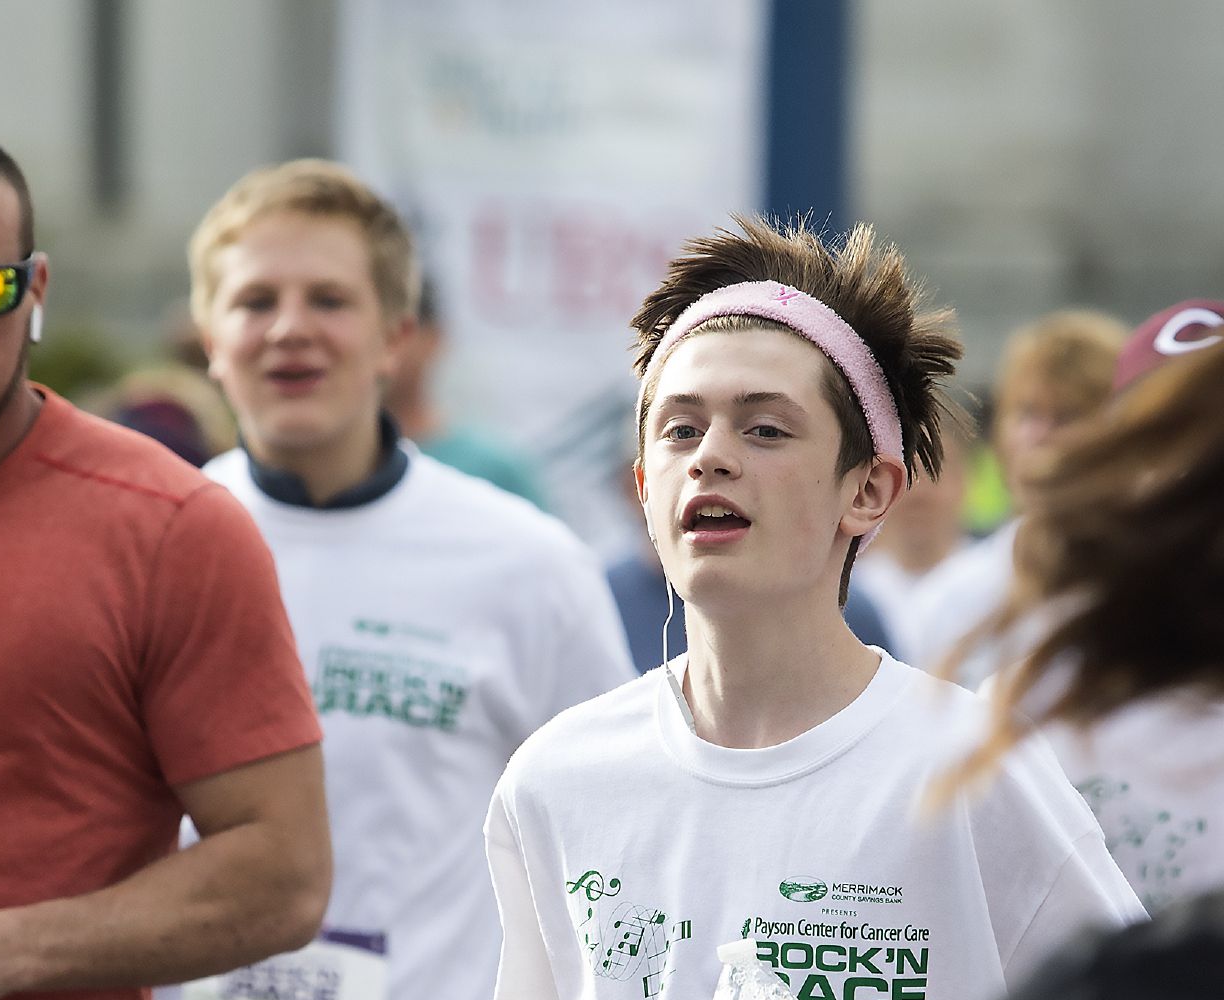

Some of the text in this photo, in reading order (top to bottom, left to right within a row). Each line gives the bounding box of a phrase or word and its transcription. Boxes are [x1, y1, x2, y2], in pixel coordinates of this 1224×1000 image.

[319, 689, 460, 735] RACE
[831, 883, 903, 896] MERRIMACK
[831, 894, 856, 902] COUNTY
[857, 896, 884, 904] SAVINGS
[821, 908, 858, 917] PRESENTS
[754, 917, 930, 942] Payson Center for Cancer Care
[756, 940, 929, 975] ROCK'N
